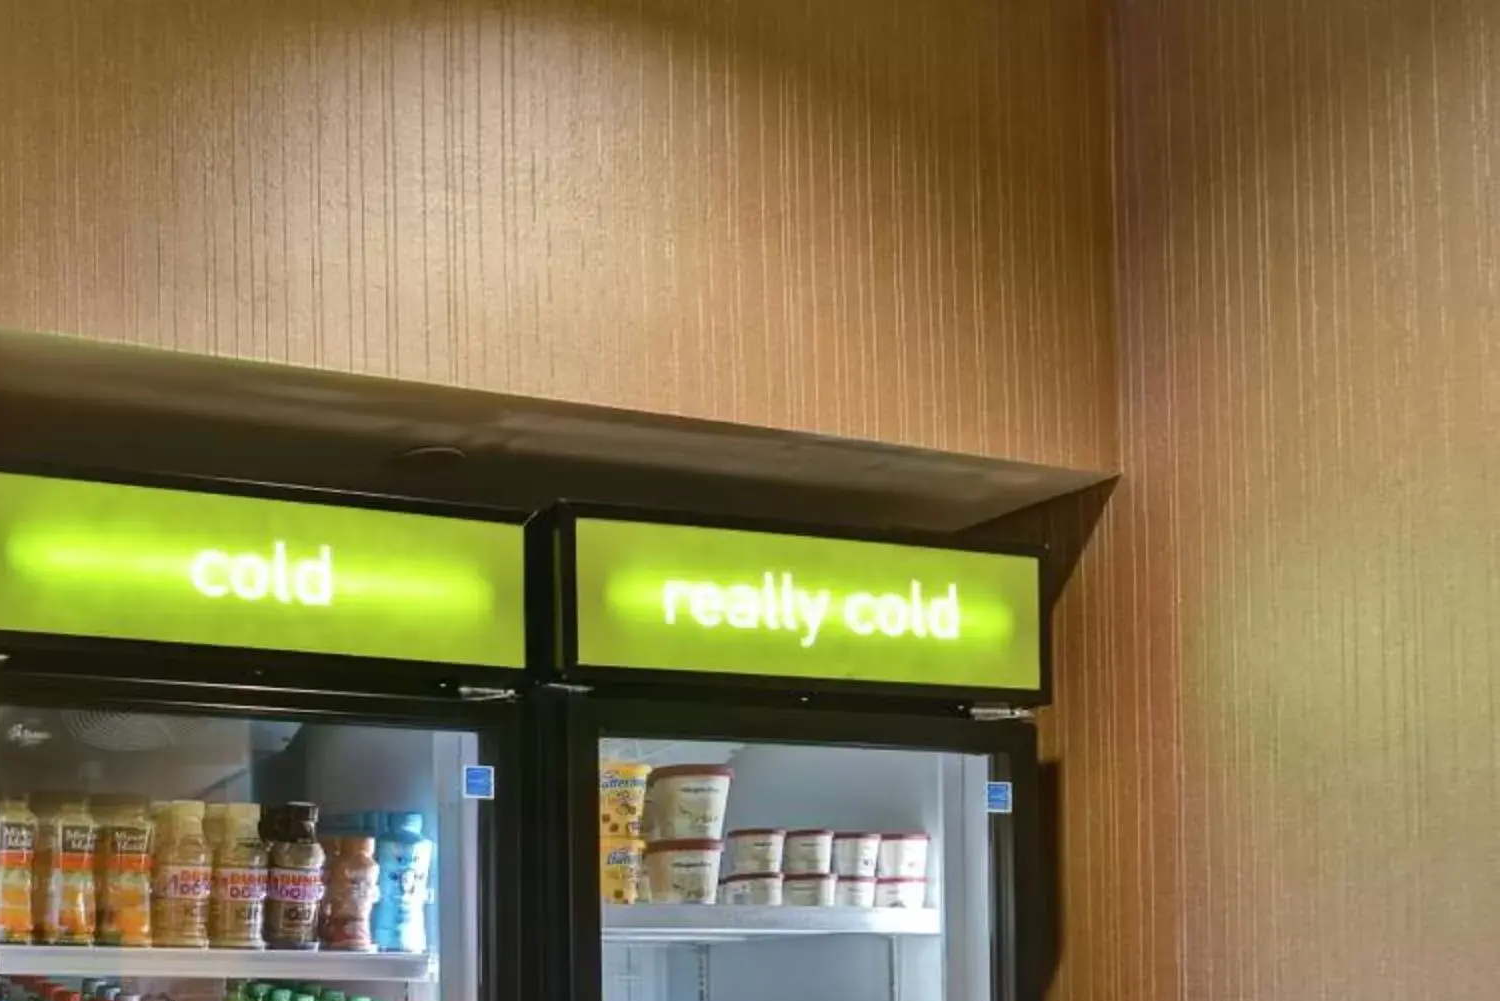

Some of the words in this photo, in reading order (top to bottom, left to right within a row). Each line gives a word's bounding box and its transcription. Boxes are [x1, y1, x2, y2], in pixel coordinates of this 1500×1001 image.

[190, 540, 335, 608] cold
[662, 571, 831, 648] really
[844, 579, 961, 641] cold
